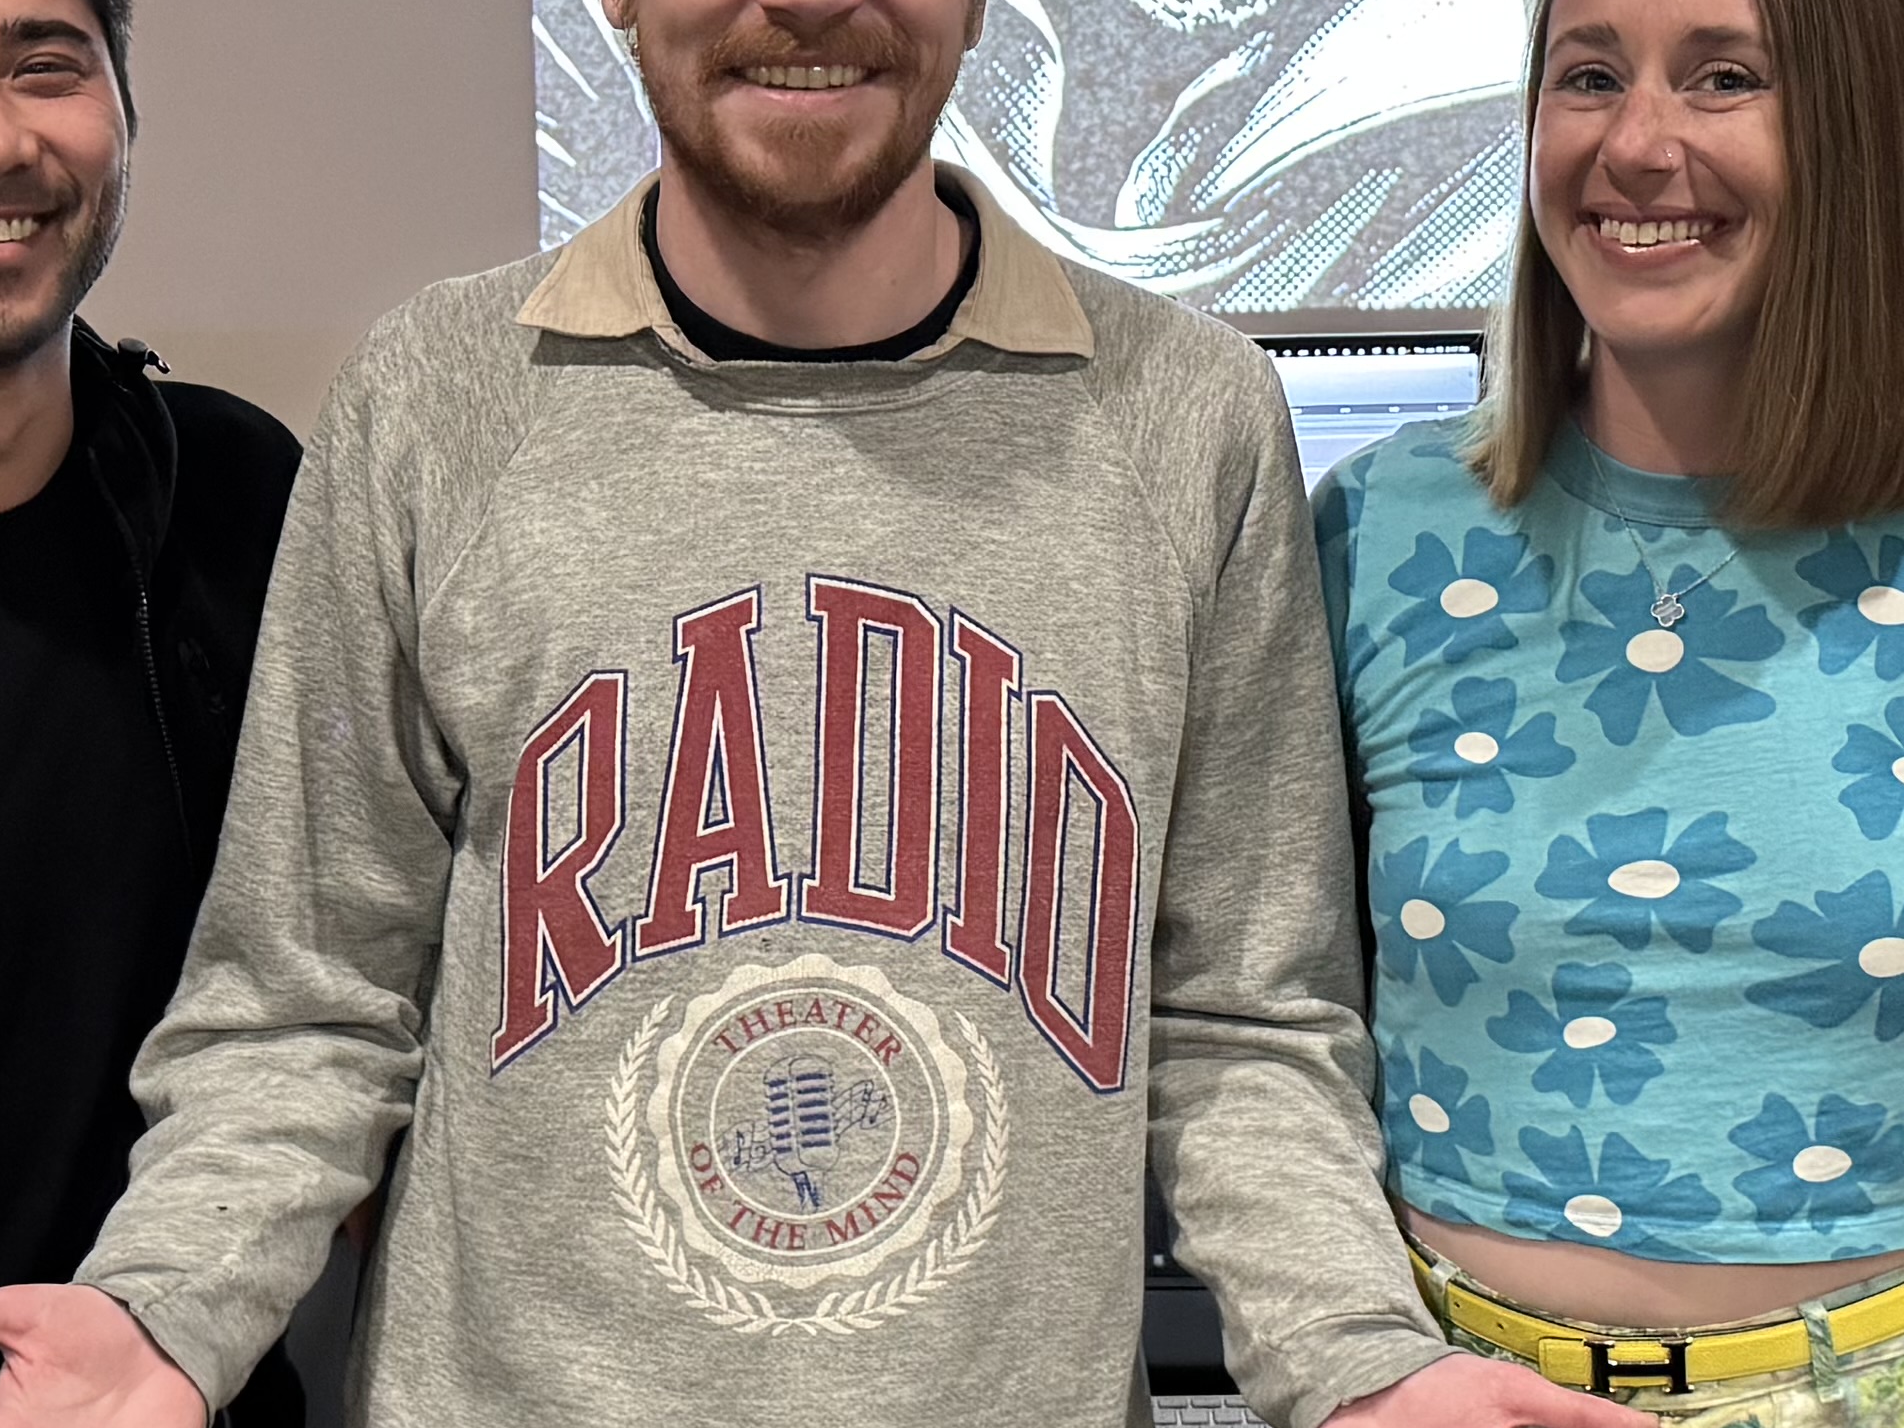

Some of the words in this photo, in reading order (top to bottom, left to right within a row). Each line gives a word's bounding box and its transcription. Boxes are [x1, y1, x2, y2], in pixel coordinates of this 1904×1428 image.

[491, 573, 1140, 1093] RADIO
[713, 997, 903, 1067] THEATER
[690, 1143, 725, 1195] OF
[727, 1199, 808, 1252] THE
[824, 1151, 921, 1246] MIND
